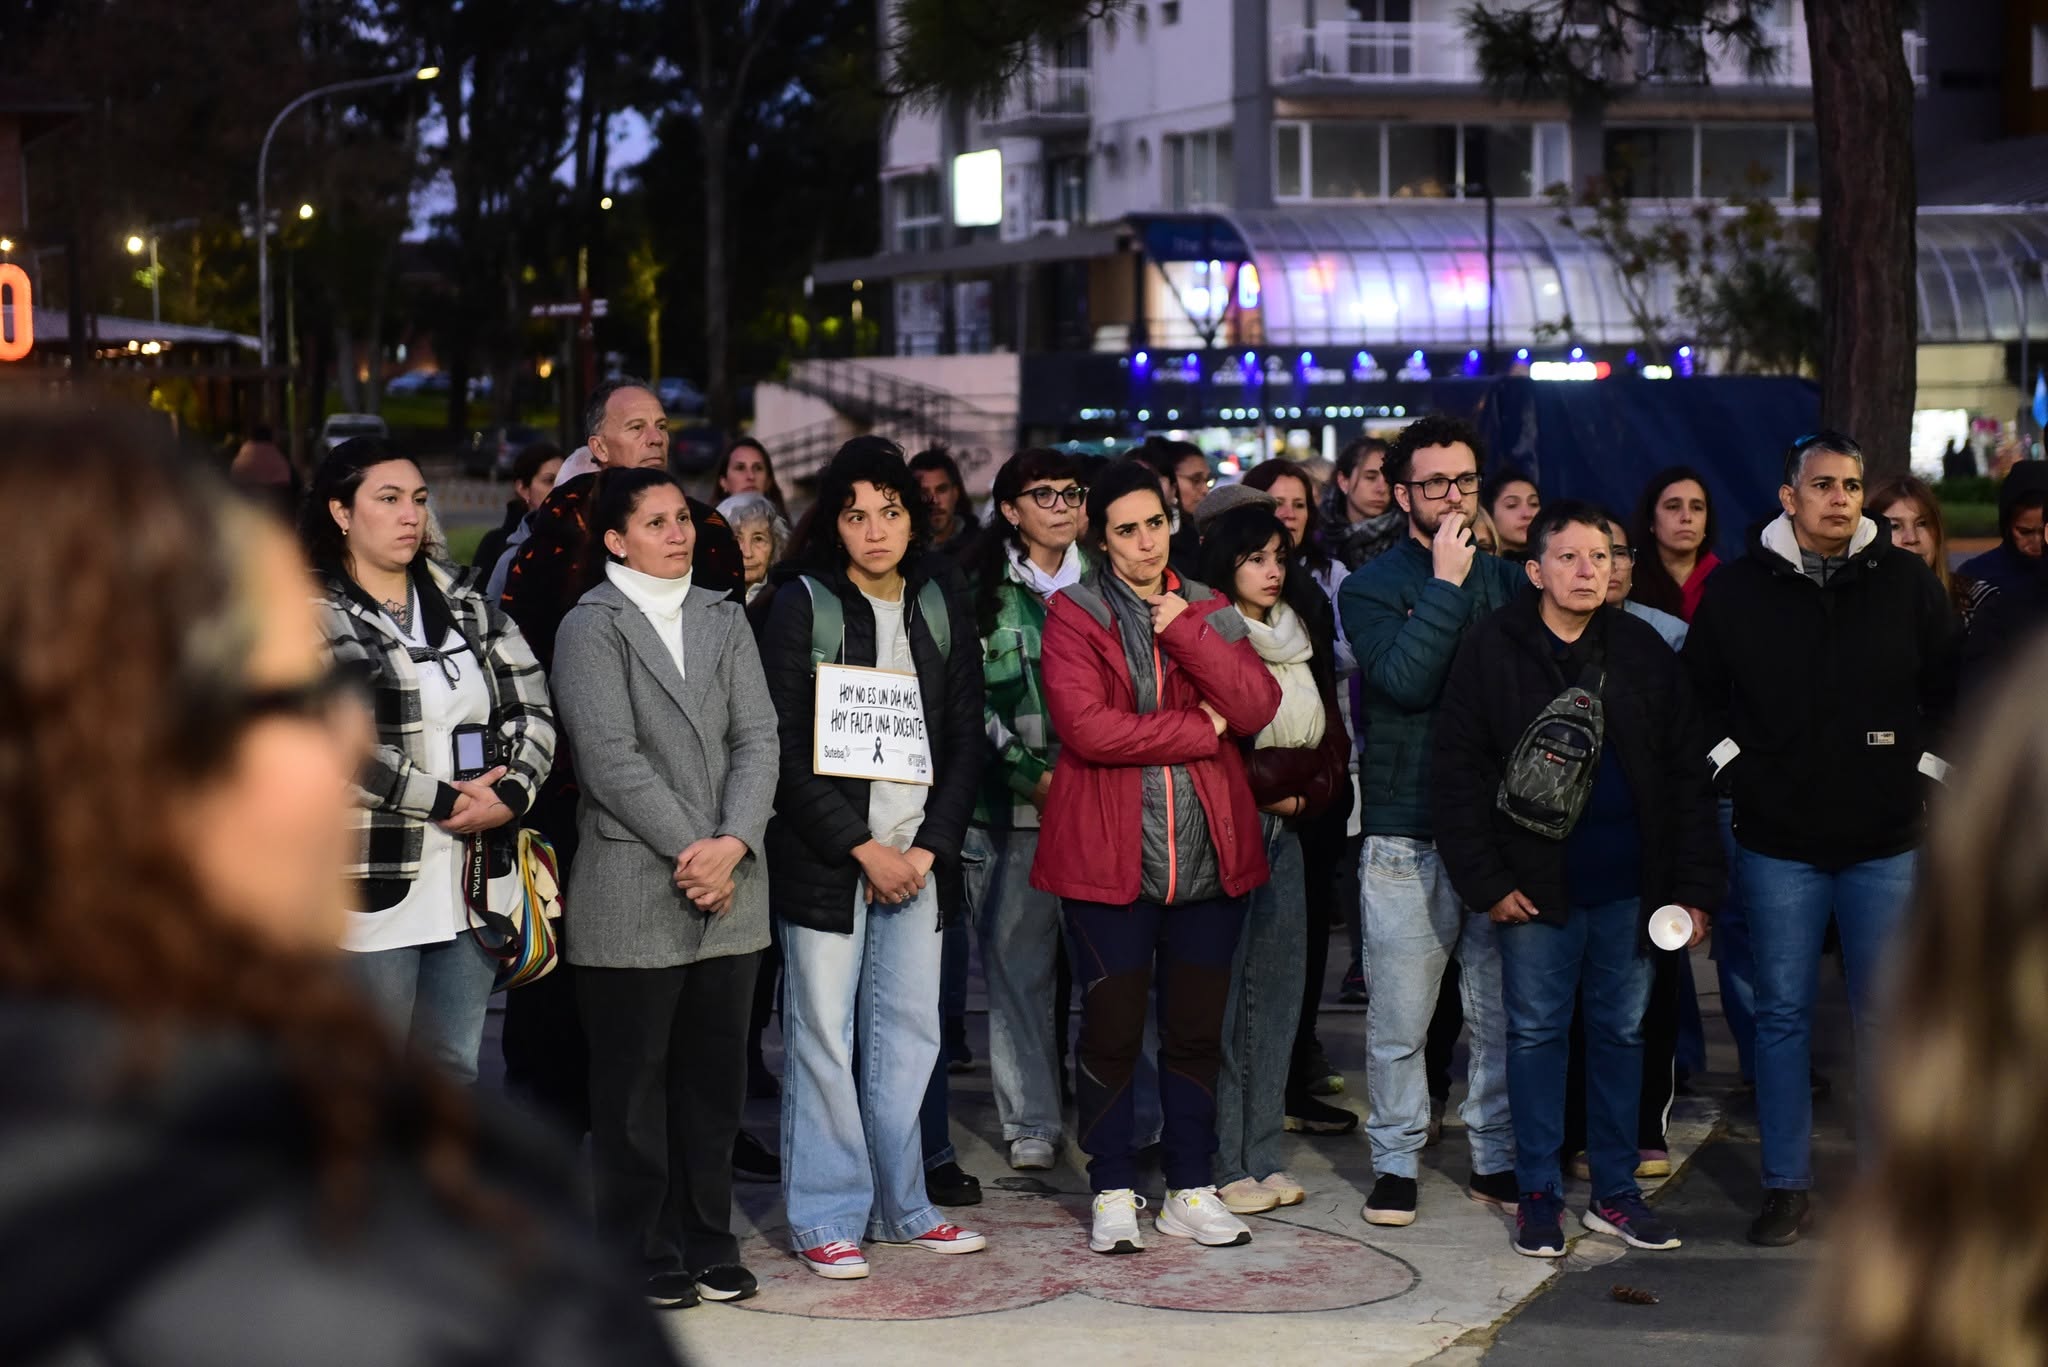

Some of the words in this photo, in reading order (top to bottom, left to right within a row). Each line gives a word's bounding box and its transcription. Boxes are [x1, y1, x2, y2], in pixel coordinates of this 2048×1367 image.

[840, 683, 854, 704] HOY
[856, 685, 865, 703] NO
[868, 687, 876, 705] ES
[879, 687, 888, 705] UN
[891, 684, 901, 707] DÍA
[903, 687, 918, 711] MÁS.
[831, 709, 848, 733] HOY
[851, 711, 872, 734] FALTA
[876, 713, 890, 735] UNA
[894, 715, 924, 740] DOCENTE.
[824, 745, 845, 759] Suteba
[472, 856, 482, 898] DIGITAL
